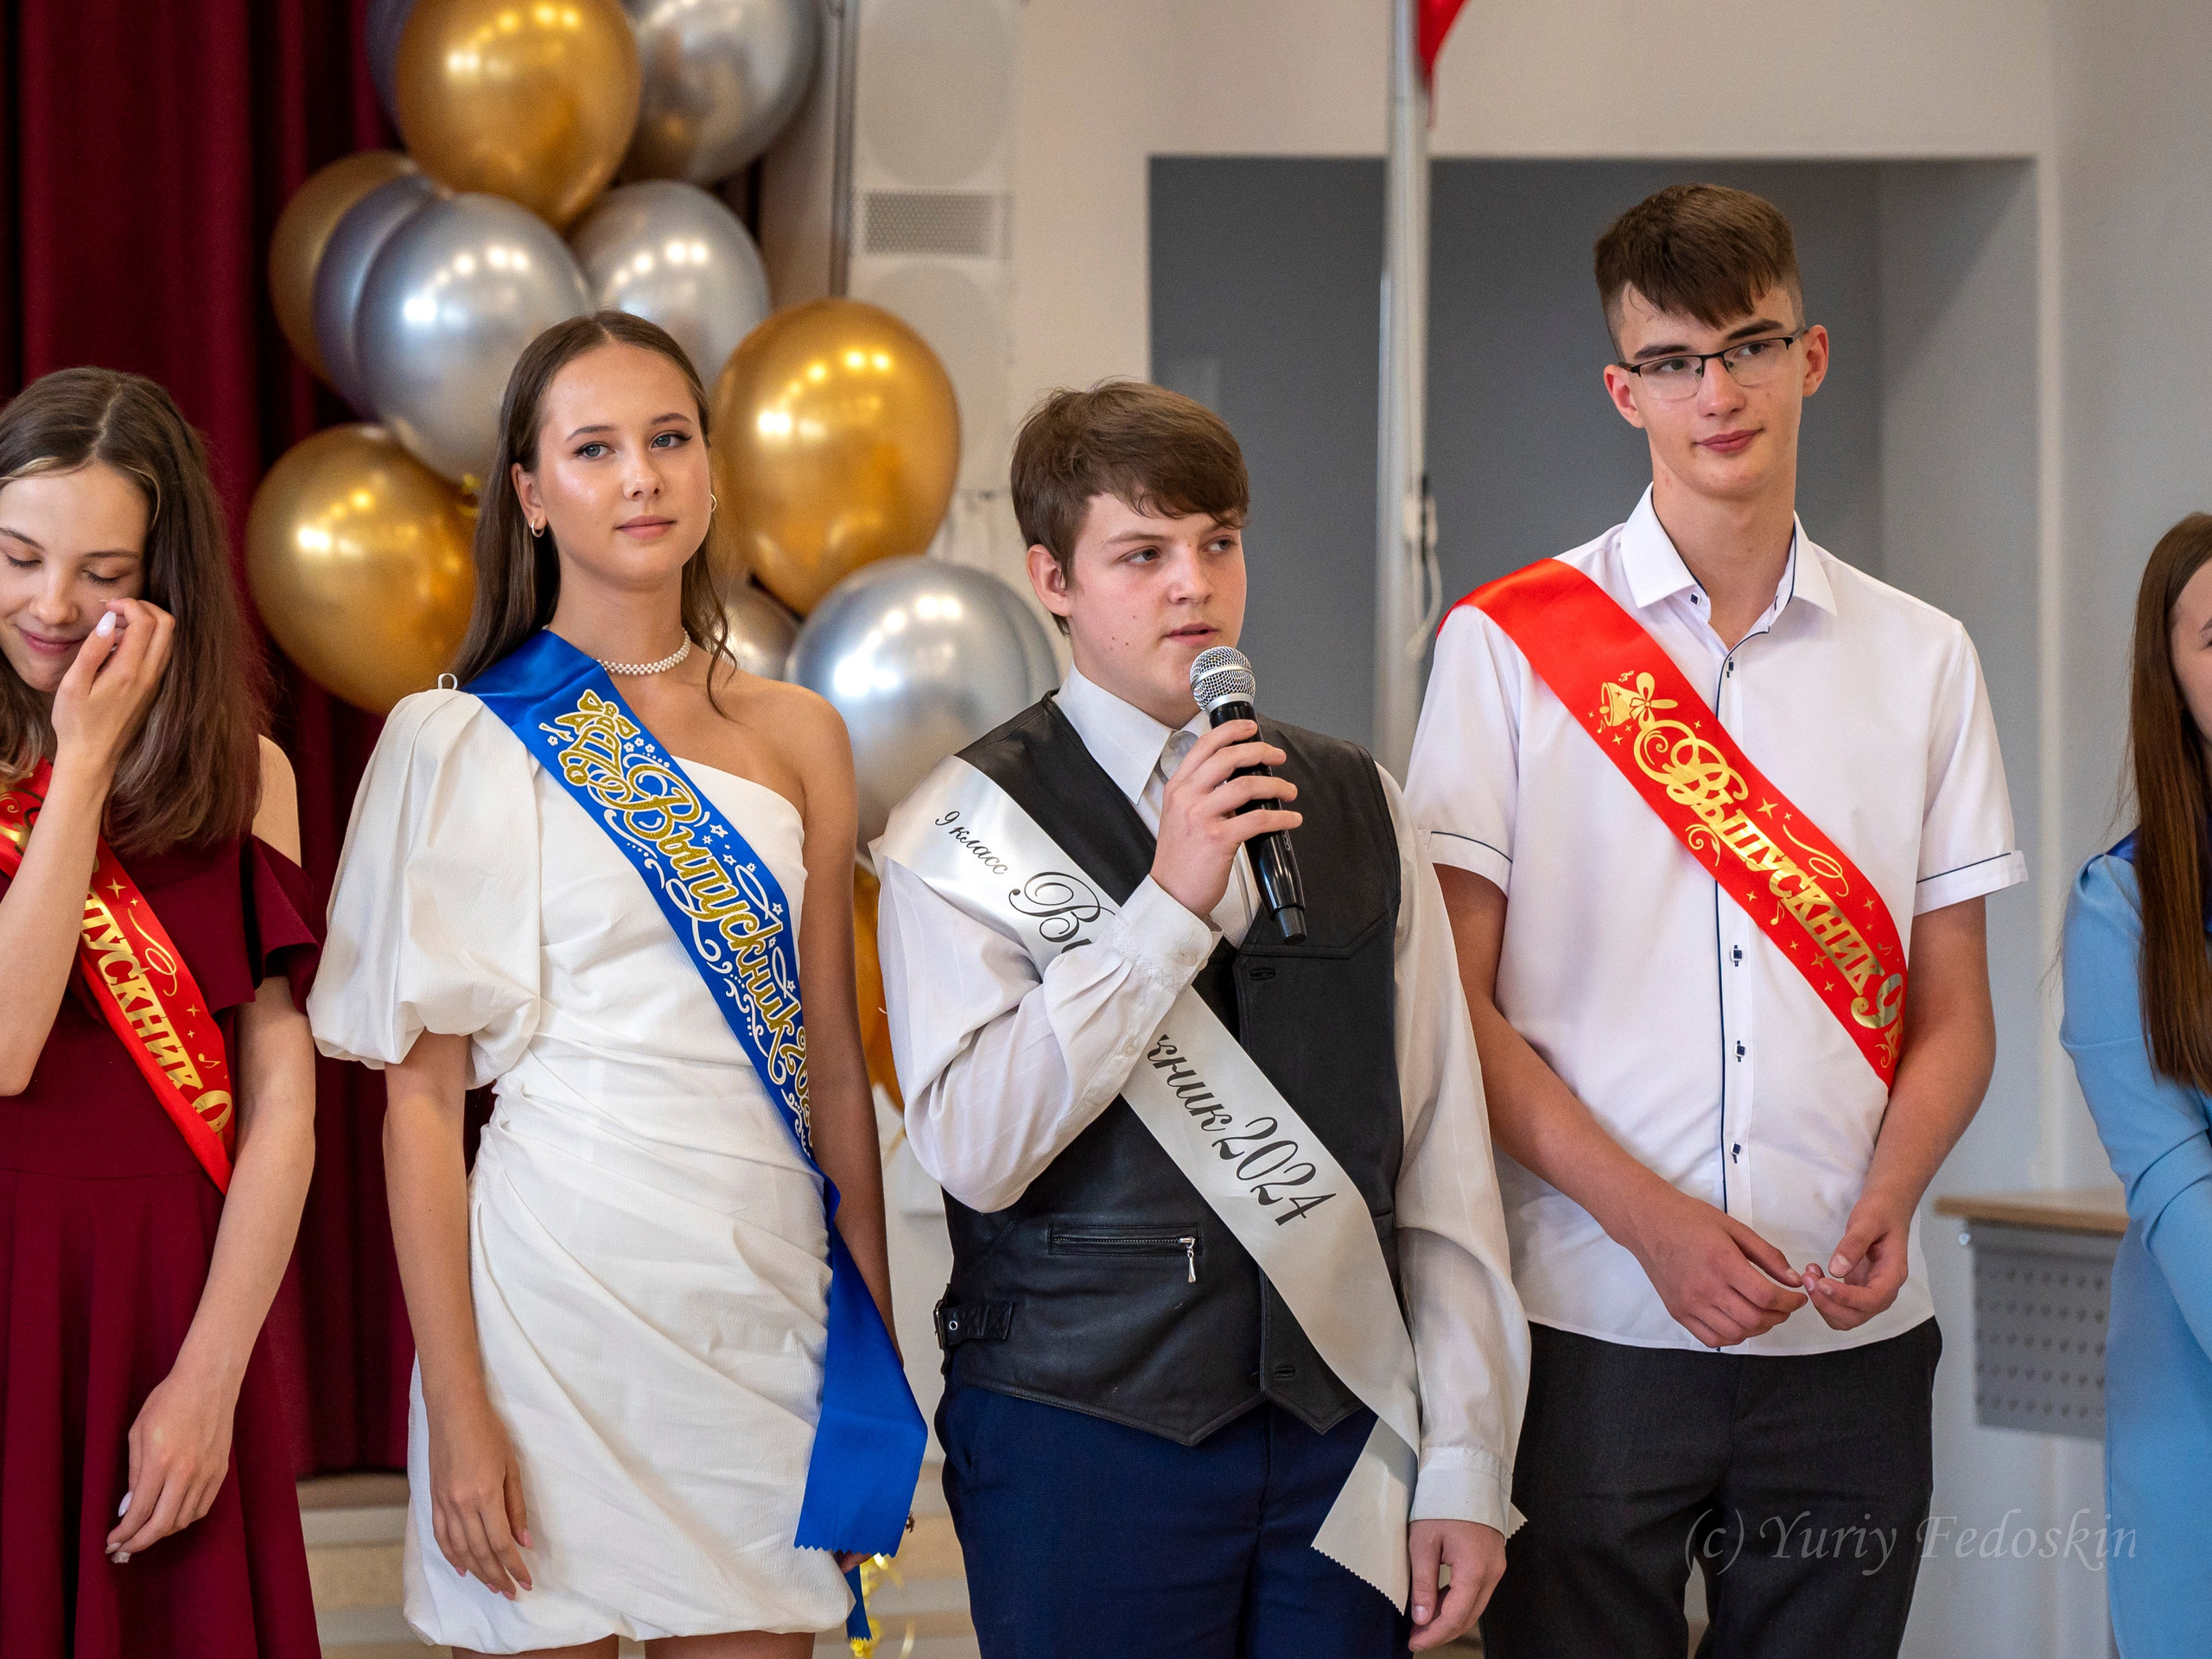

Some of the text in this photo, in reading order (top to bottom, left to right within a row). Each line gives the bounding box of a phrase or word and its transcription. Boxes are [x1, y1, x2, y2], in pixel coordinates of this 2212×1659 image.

[935, 810, 1008, 874] 9 класс
[1211, 1116, 1337, 1226] 2024
